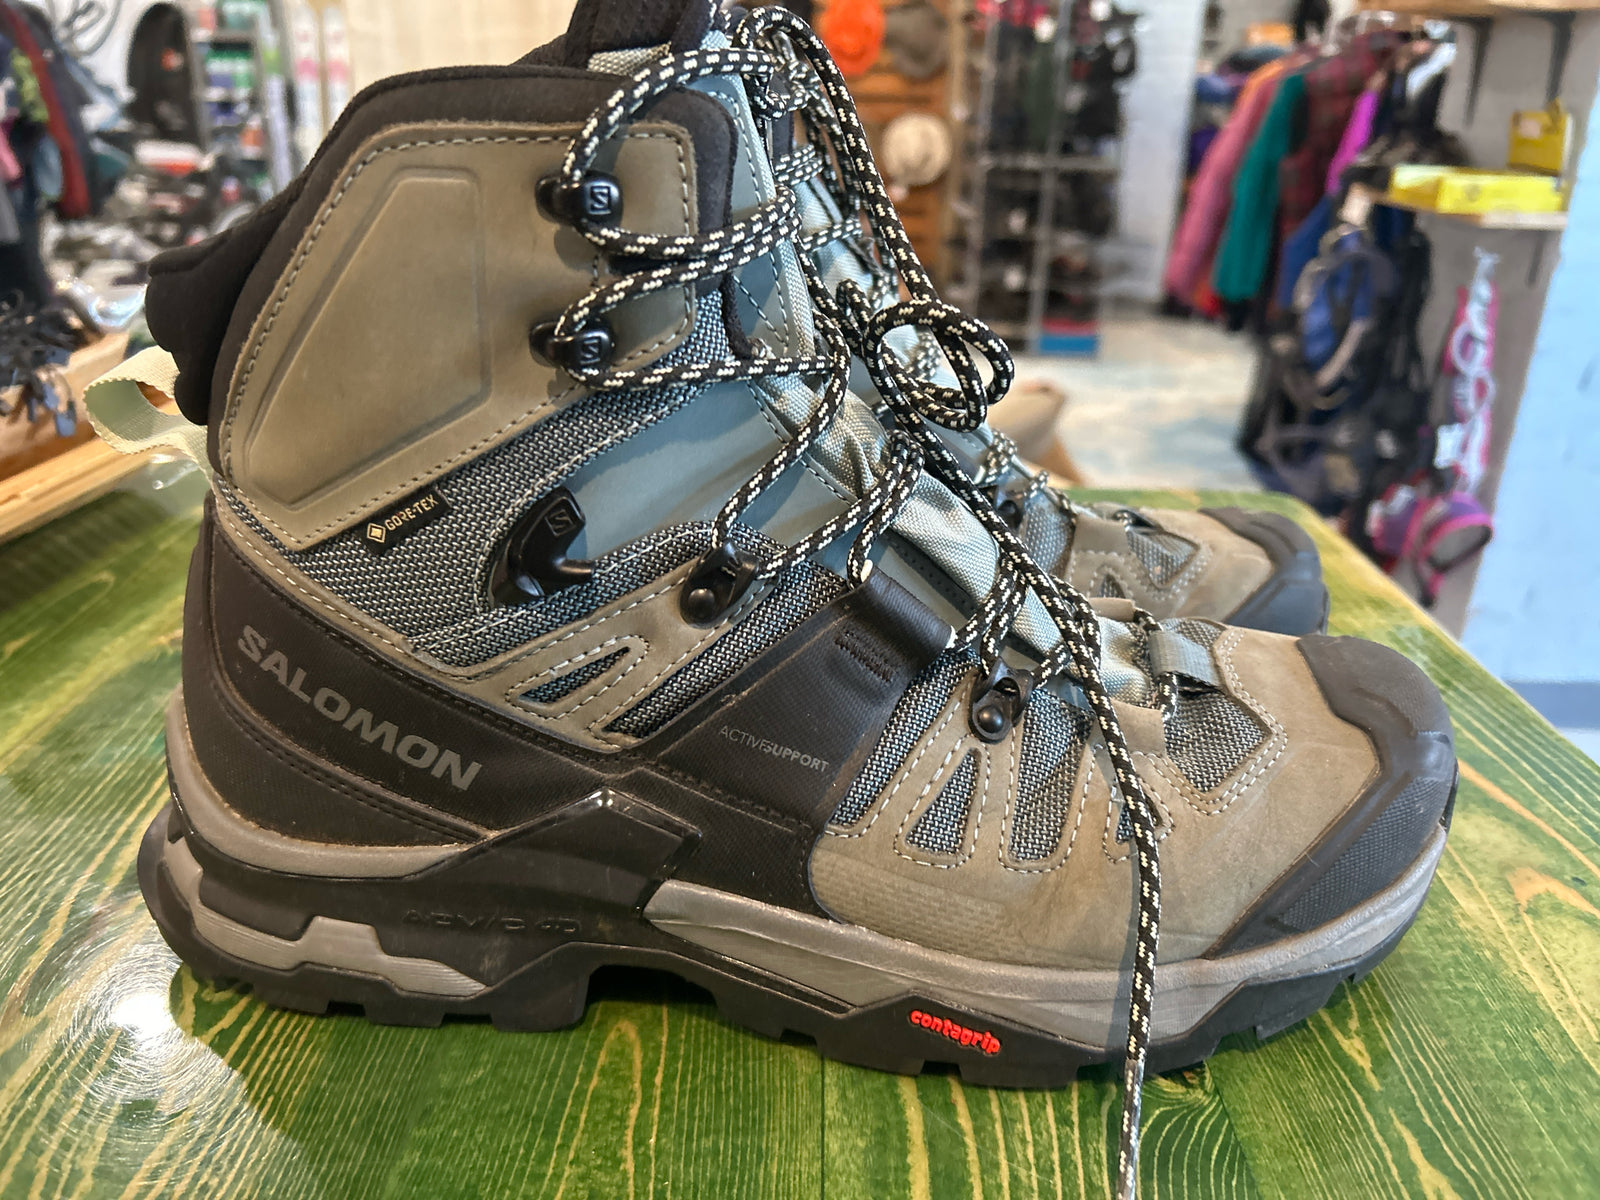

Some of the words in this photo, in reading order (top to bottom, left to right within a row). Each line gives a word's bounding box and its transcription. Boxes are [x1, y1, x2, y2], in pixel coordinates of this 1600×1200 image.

[385, 494, 439, 531] GORE-TEX
[237, 625, 483, 792] SALOMON
[719, 725, 830, 773] ACTIVESUPPORT
[910, 1009, 1001, 1056] contagrip
